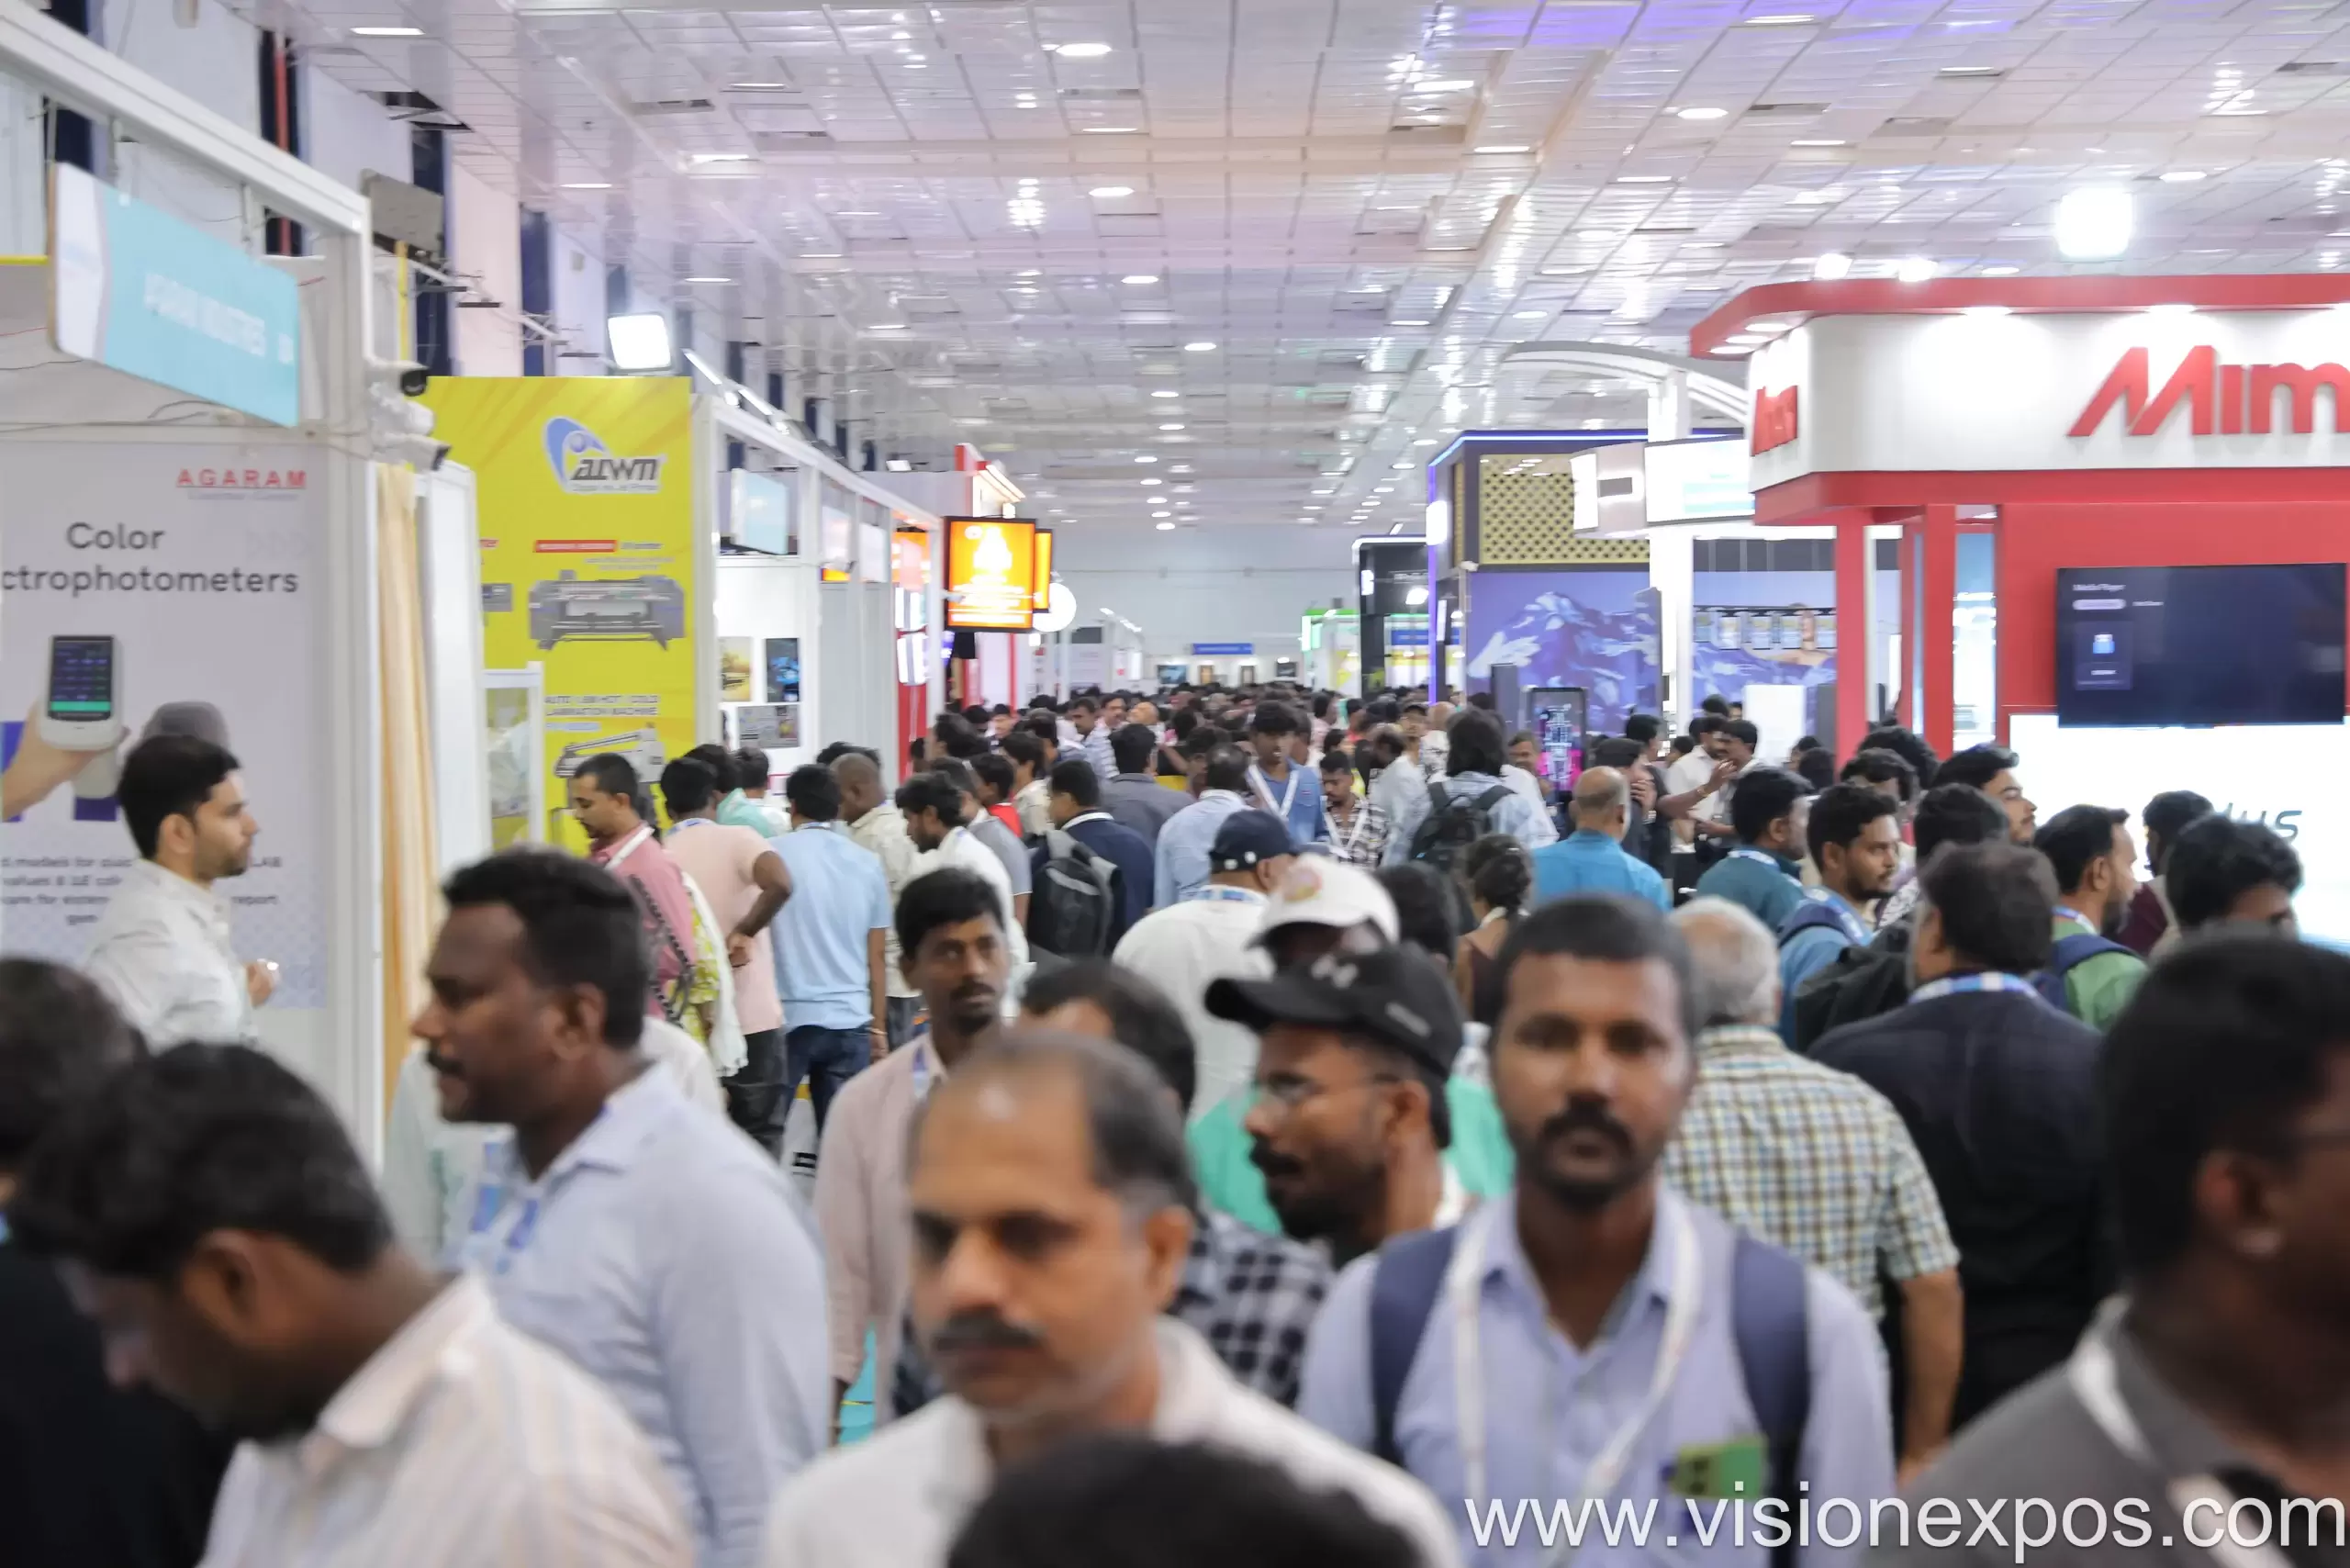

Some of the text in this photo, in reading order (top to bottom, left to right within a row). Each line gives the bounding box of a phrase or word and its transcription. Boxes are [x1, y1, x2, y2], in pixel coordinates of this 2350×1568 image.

[176, 468, 307, 487] AGARAM
[66, 521, 165, 551] Color
[1, 564, 299, 599] ctrophotometers
